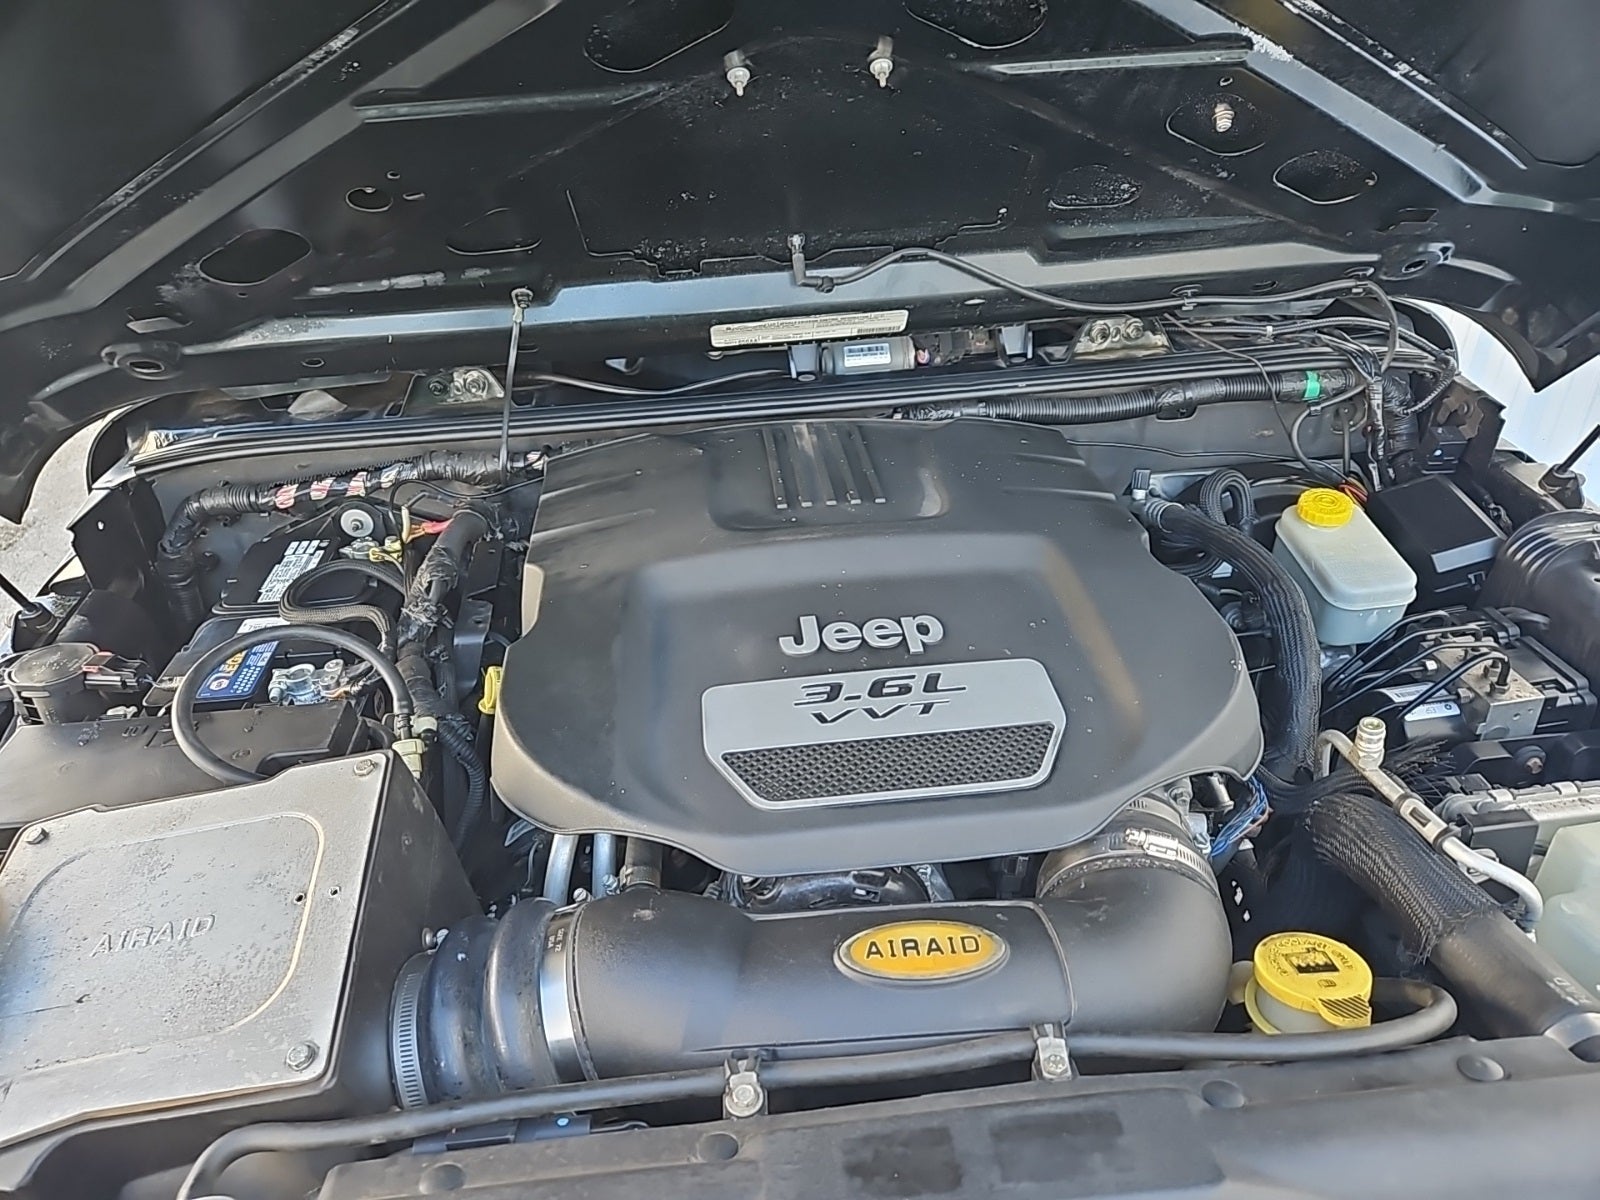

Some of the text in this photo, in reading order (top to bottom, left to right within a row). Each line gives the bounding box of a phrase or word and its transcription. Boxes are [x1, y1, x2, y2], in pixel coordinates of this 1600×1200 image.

[778, 614, 944, 656] Jeep
[794, 672, 967, 706] 3.6L
[811, 700, 951, 725] VVT
[89, 914, 216, 957] AIRAID
[864, 935, 981, 960] AIRAID
